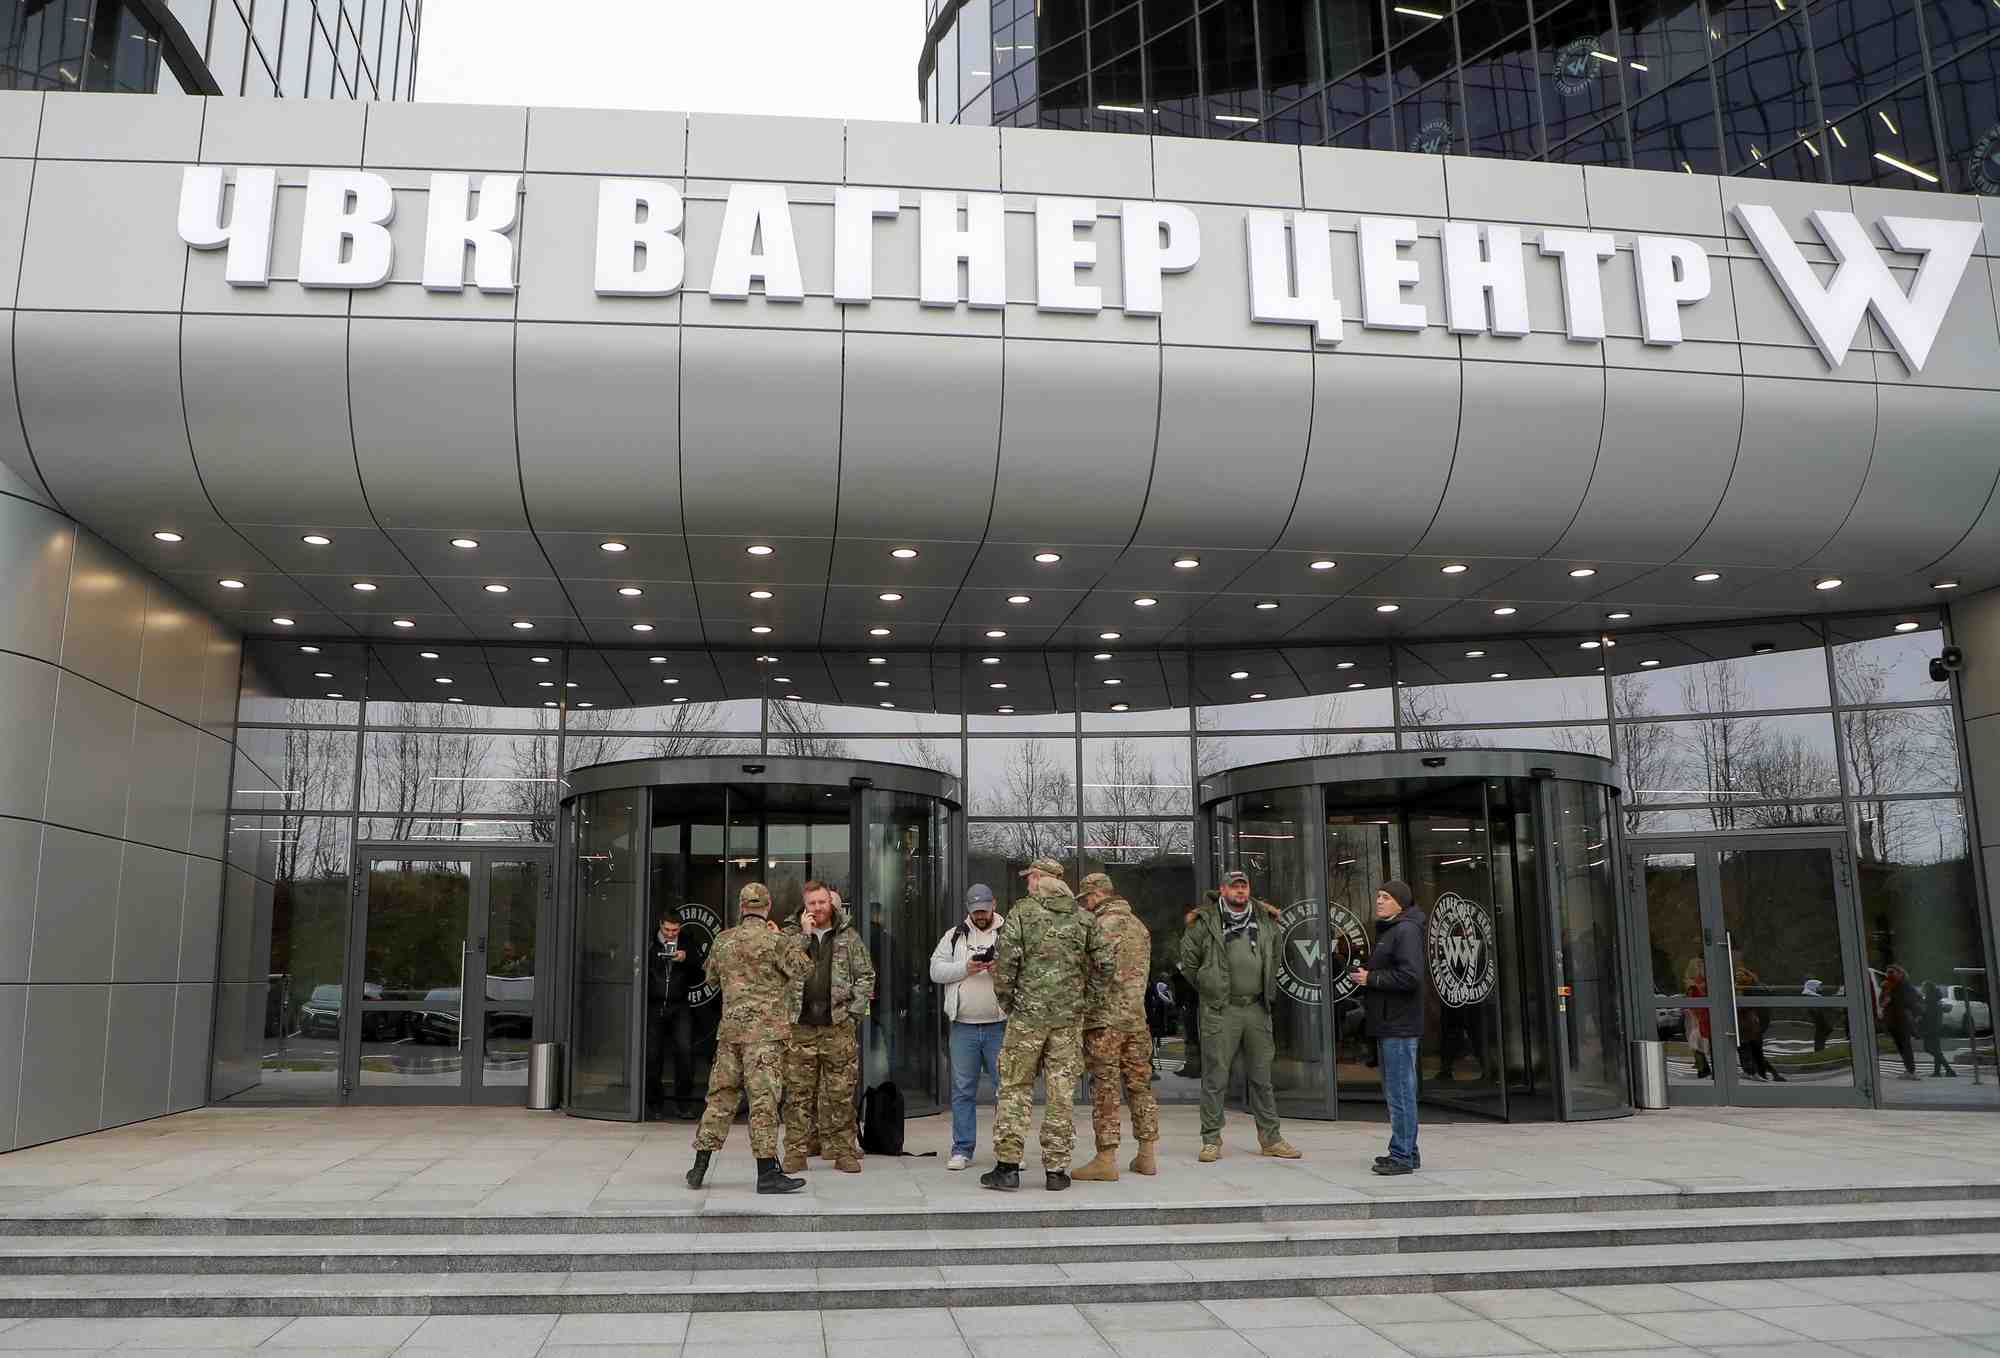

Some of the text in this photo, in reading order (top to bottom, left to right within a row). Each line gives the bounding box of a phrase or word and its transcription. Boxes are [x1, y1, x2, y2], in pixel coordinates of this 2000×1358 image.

[177, 166, 1711, 346] ЧВК ВАГНЕР ЦЕНТР
